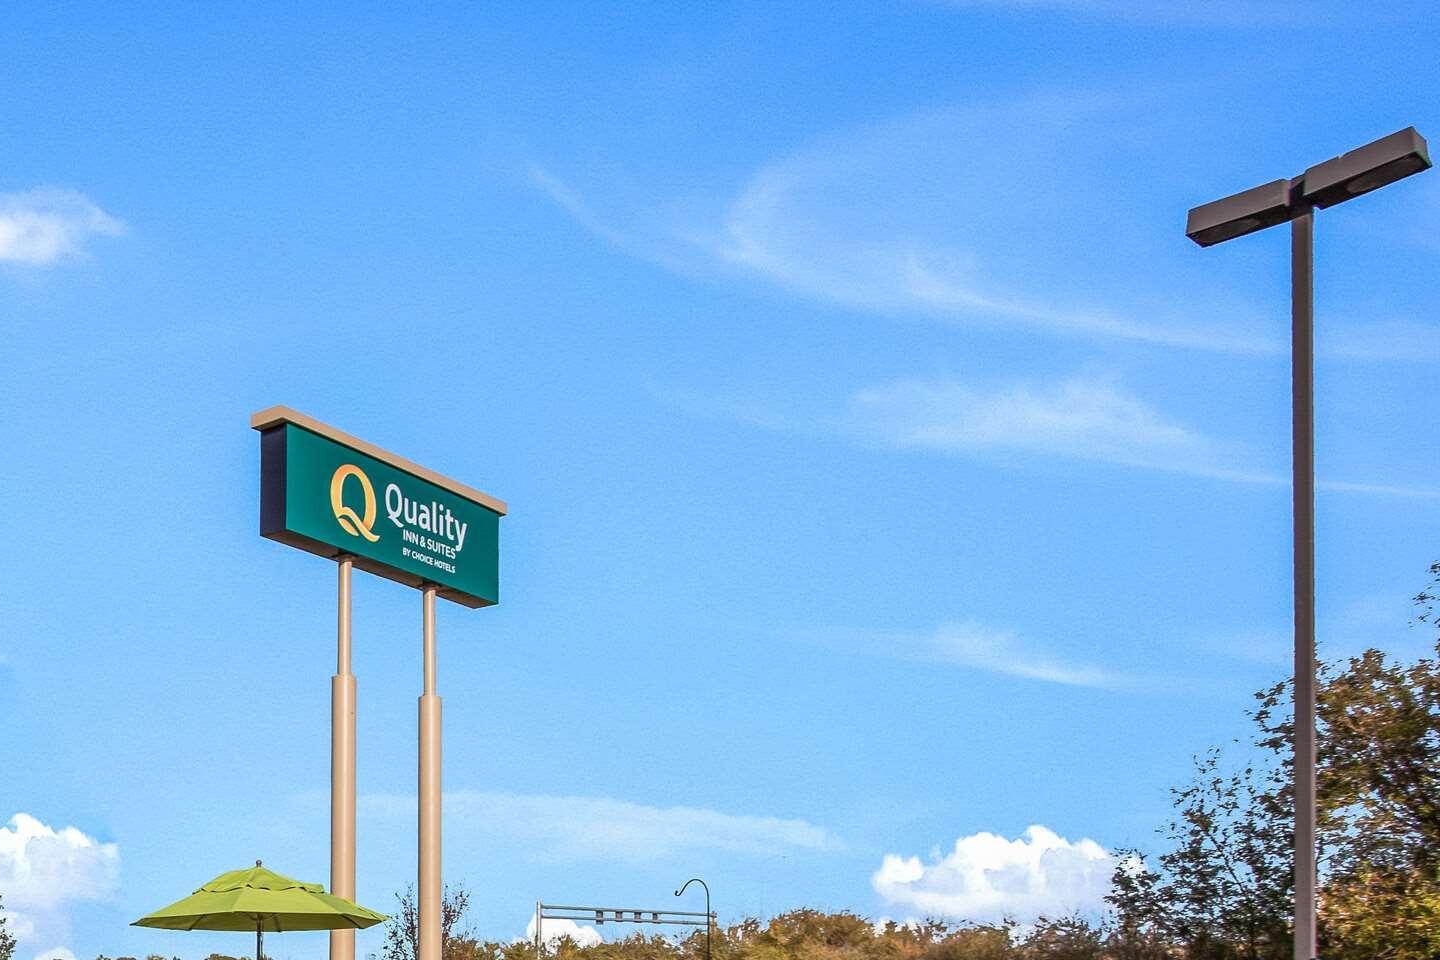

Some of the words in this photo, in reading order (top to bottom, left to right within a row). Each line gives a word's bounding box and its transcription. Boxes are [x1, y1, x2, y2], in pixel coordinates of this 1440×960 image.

[385, 483, 468, 551] Quality
[403, 529, 419, 545] INN
[420, 535, 426, 547] &
[426, 538, 456, 559] SUITES
[402, 547, 411, 557] BY
[411, 550, 434, 566] CHOICE
[434, 557, 456, 574] HOTELS
